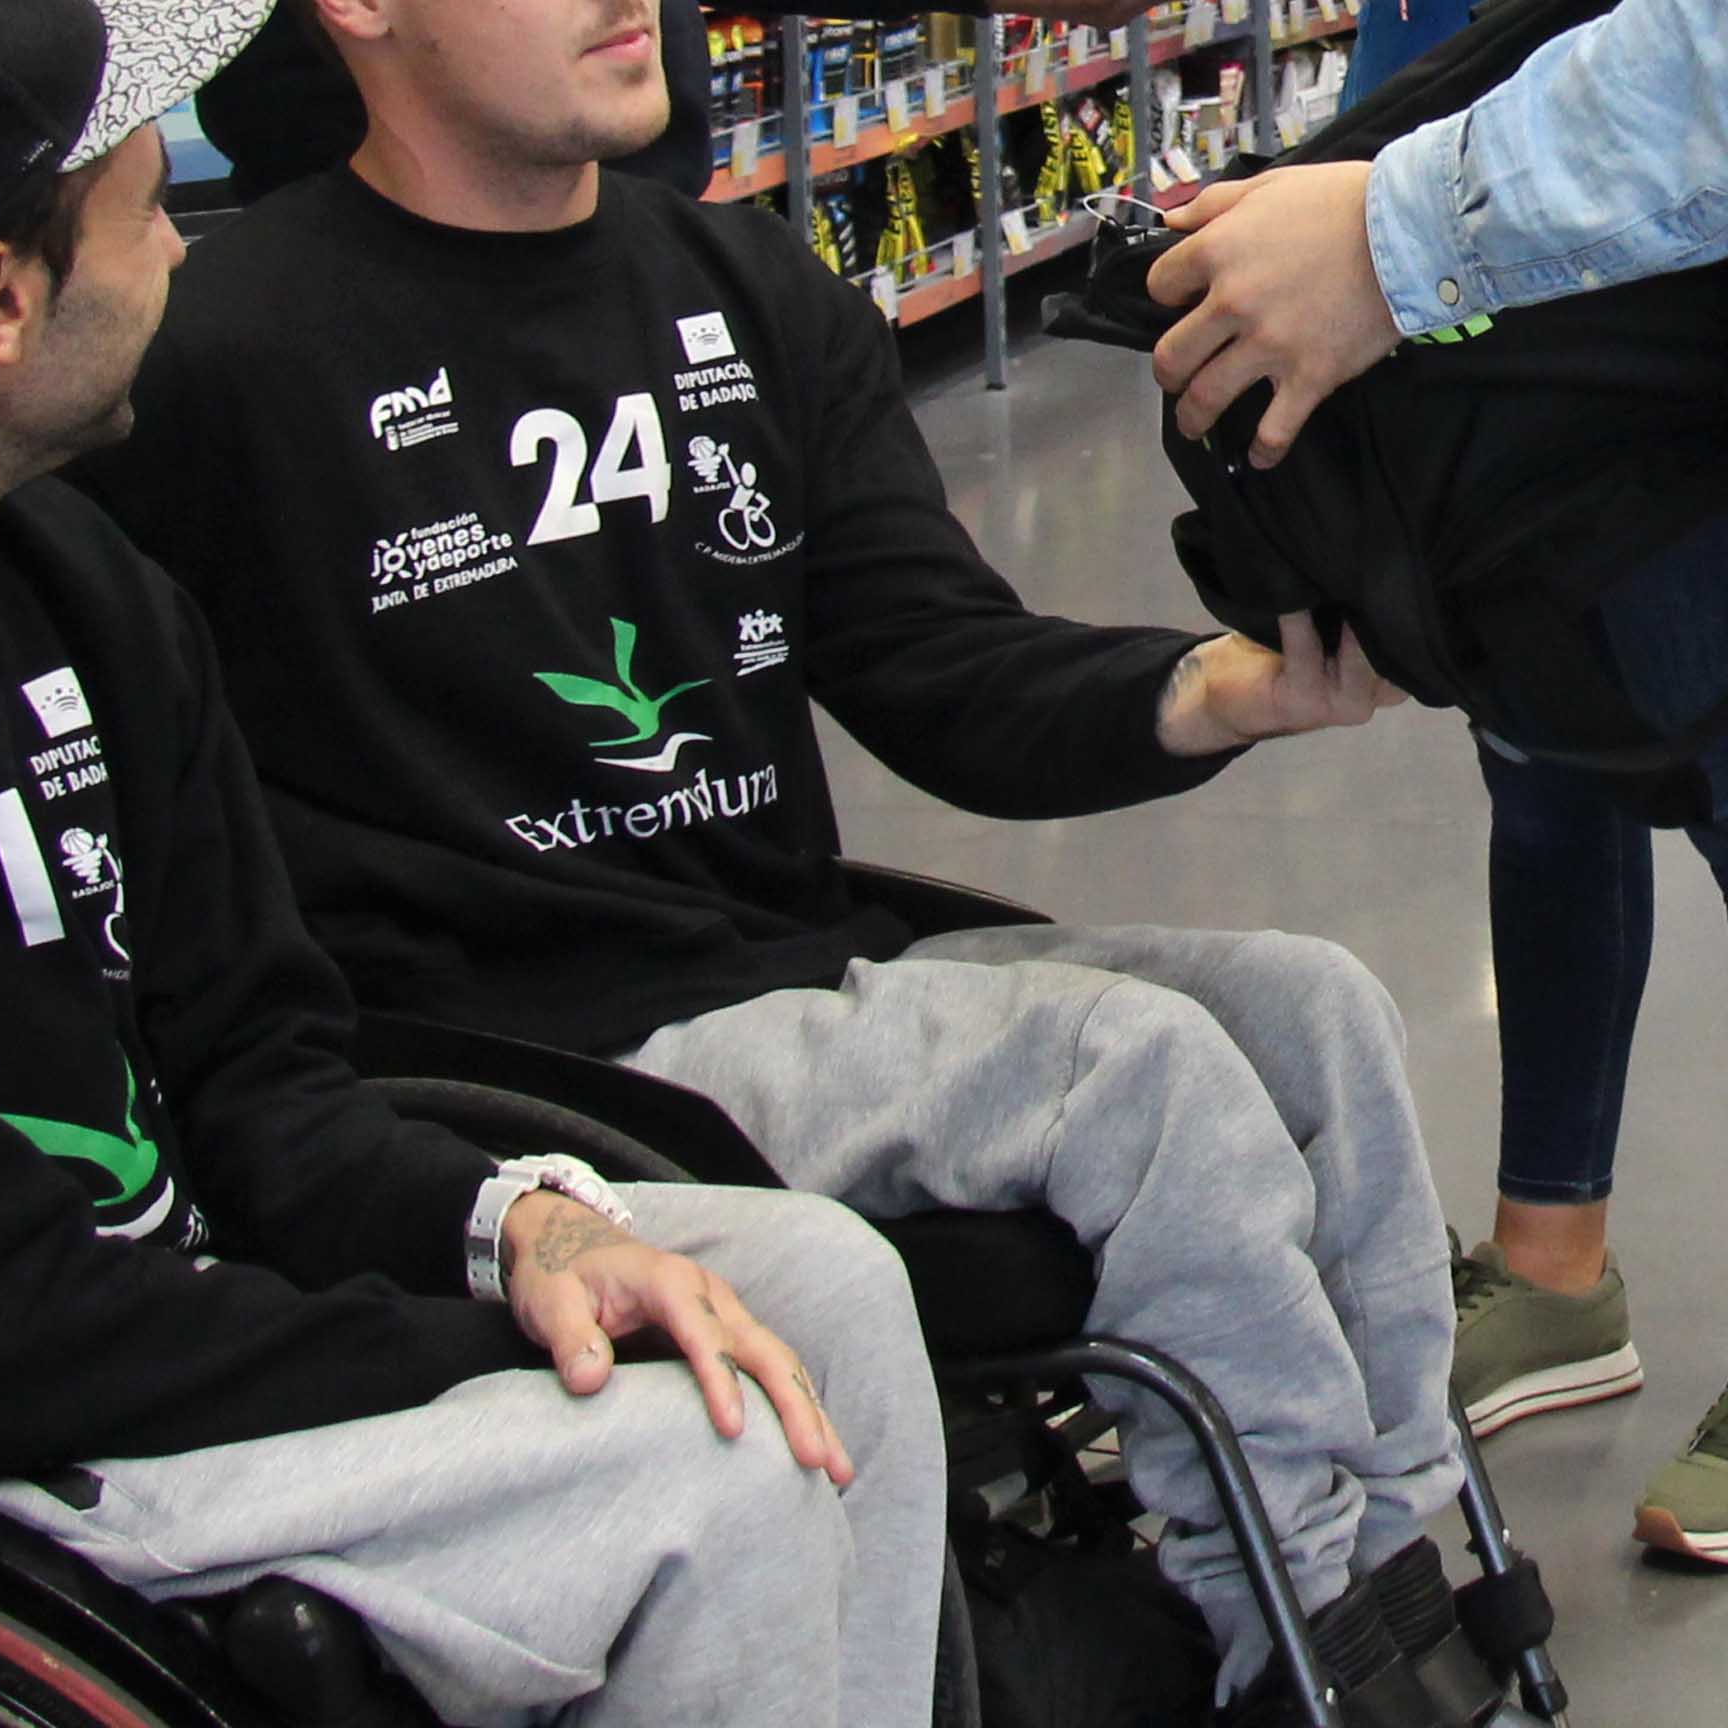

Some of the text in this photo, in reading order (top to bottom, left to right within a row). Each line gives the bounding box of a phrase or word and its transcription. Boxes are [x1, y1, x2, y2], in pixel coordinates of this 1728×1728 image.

[674, 358, 754, 391] DIPUTACIÓ
[679, 383, 759, 412] DE BADAJO
[510, 392, 671, 546] 24
[410, 512, 478, 541] fundación
[371, 555, 519, 614] JUNTA DE EXTREMADURA
[40, 775, 66, 801] DE
